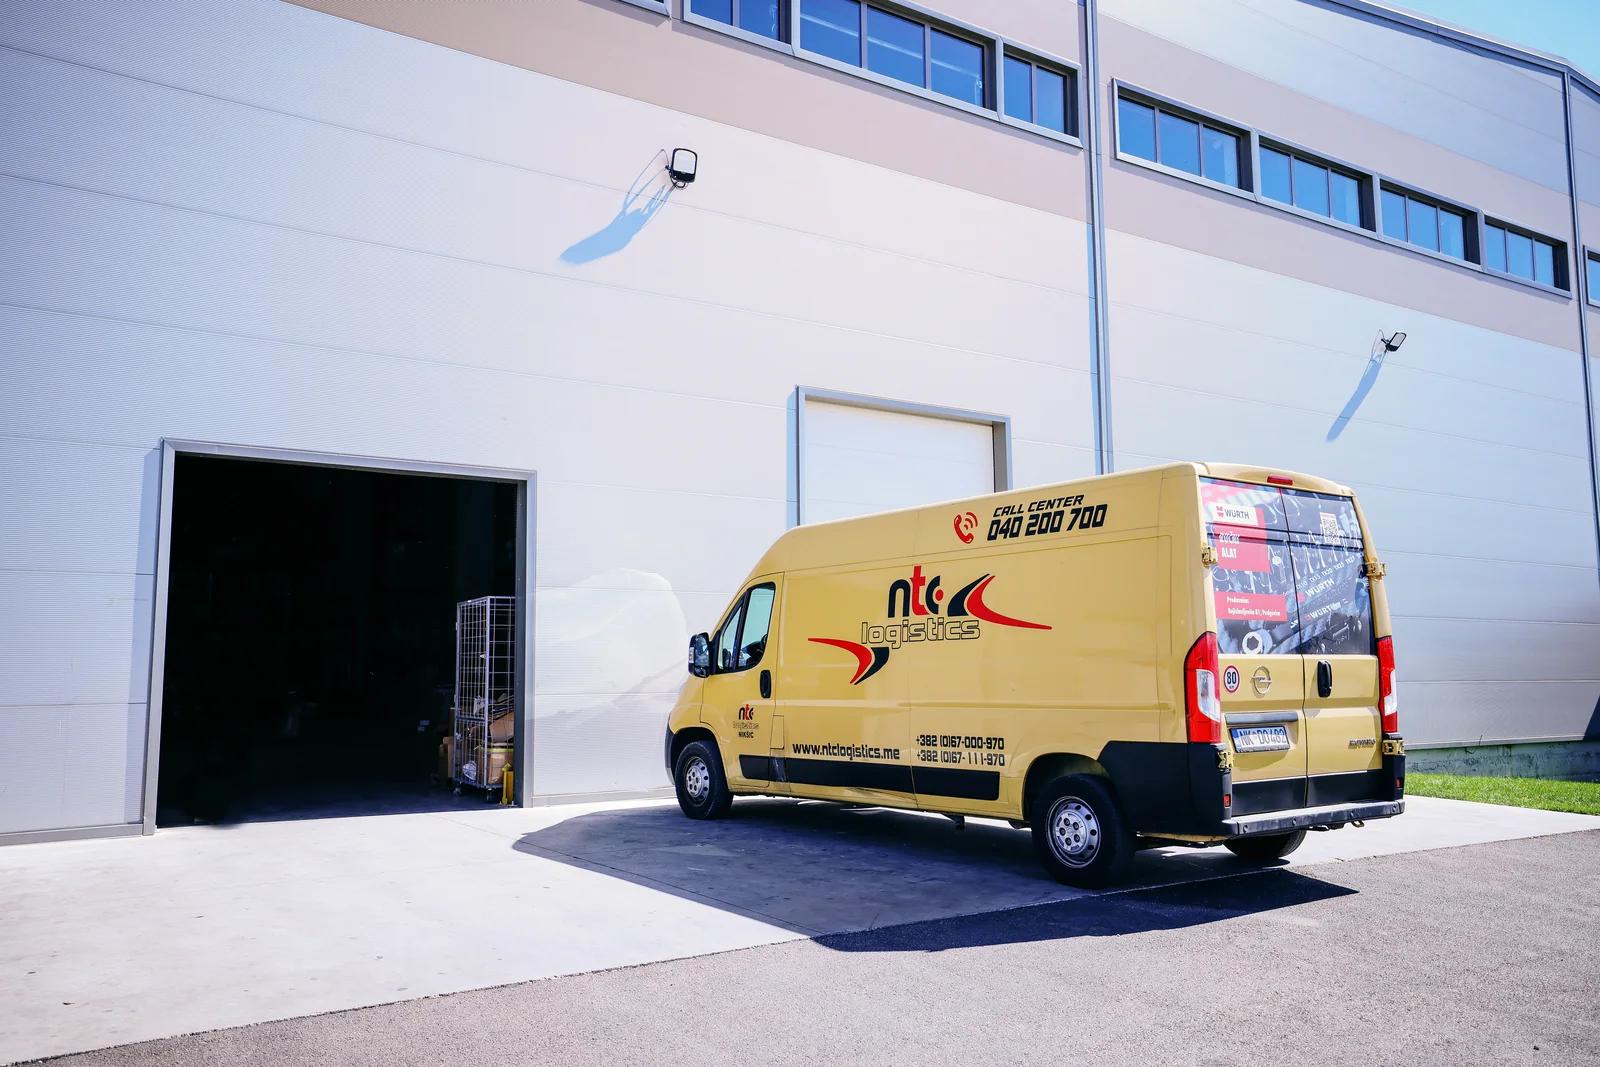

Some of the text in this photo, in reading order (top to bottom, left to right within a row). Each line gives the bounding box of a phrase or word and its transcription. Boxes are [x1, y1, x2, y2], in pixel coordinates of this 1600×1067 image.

[993, 494, 1084, 517] CALL CENTER
[987, 504, 1108, 541] 040 200 700
[861, 617, 981, 650] logistics
[1226, 671, 1237, 684] 80
[916, 735, 1005, 750] +382 (0)67-000-970
[792, 743, 900, 760] www.ntclogistics.me
[917, 750, 938, 762] +382
